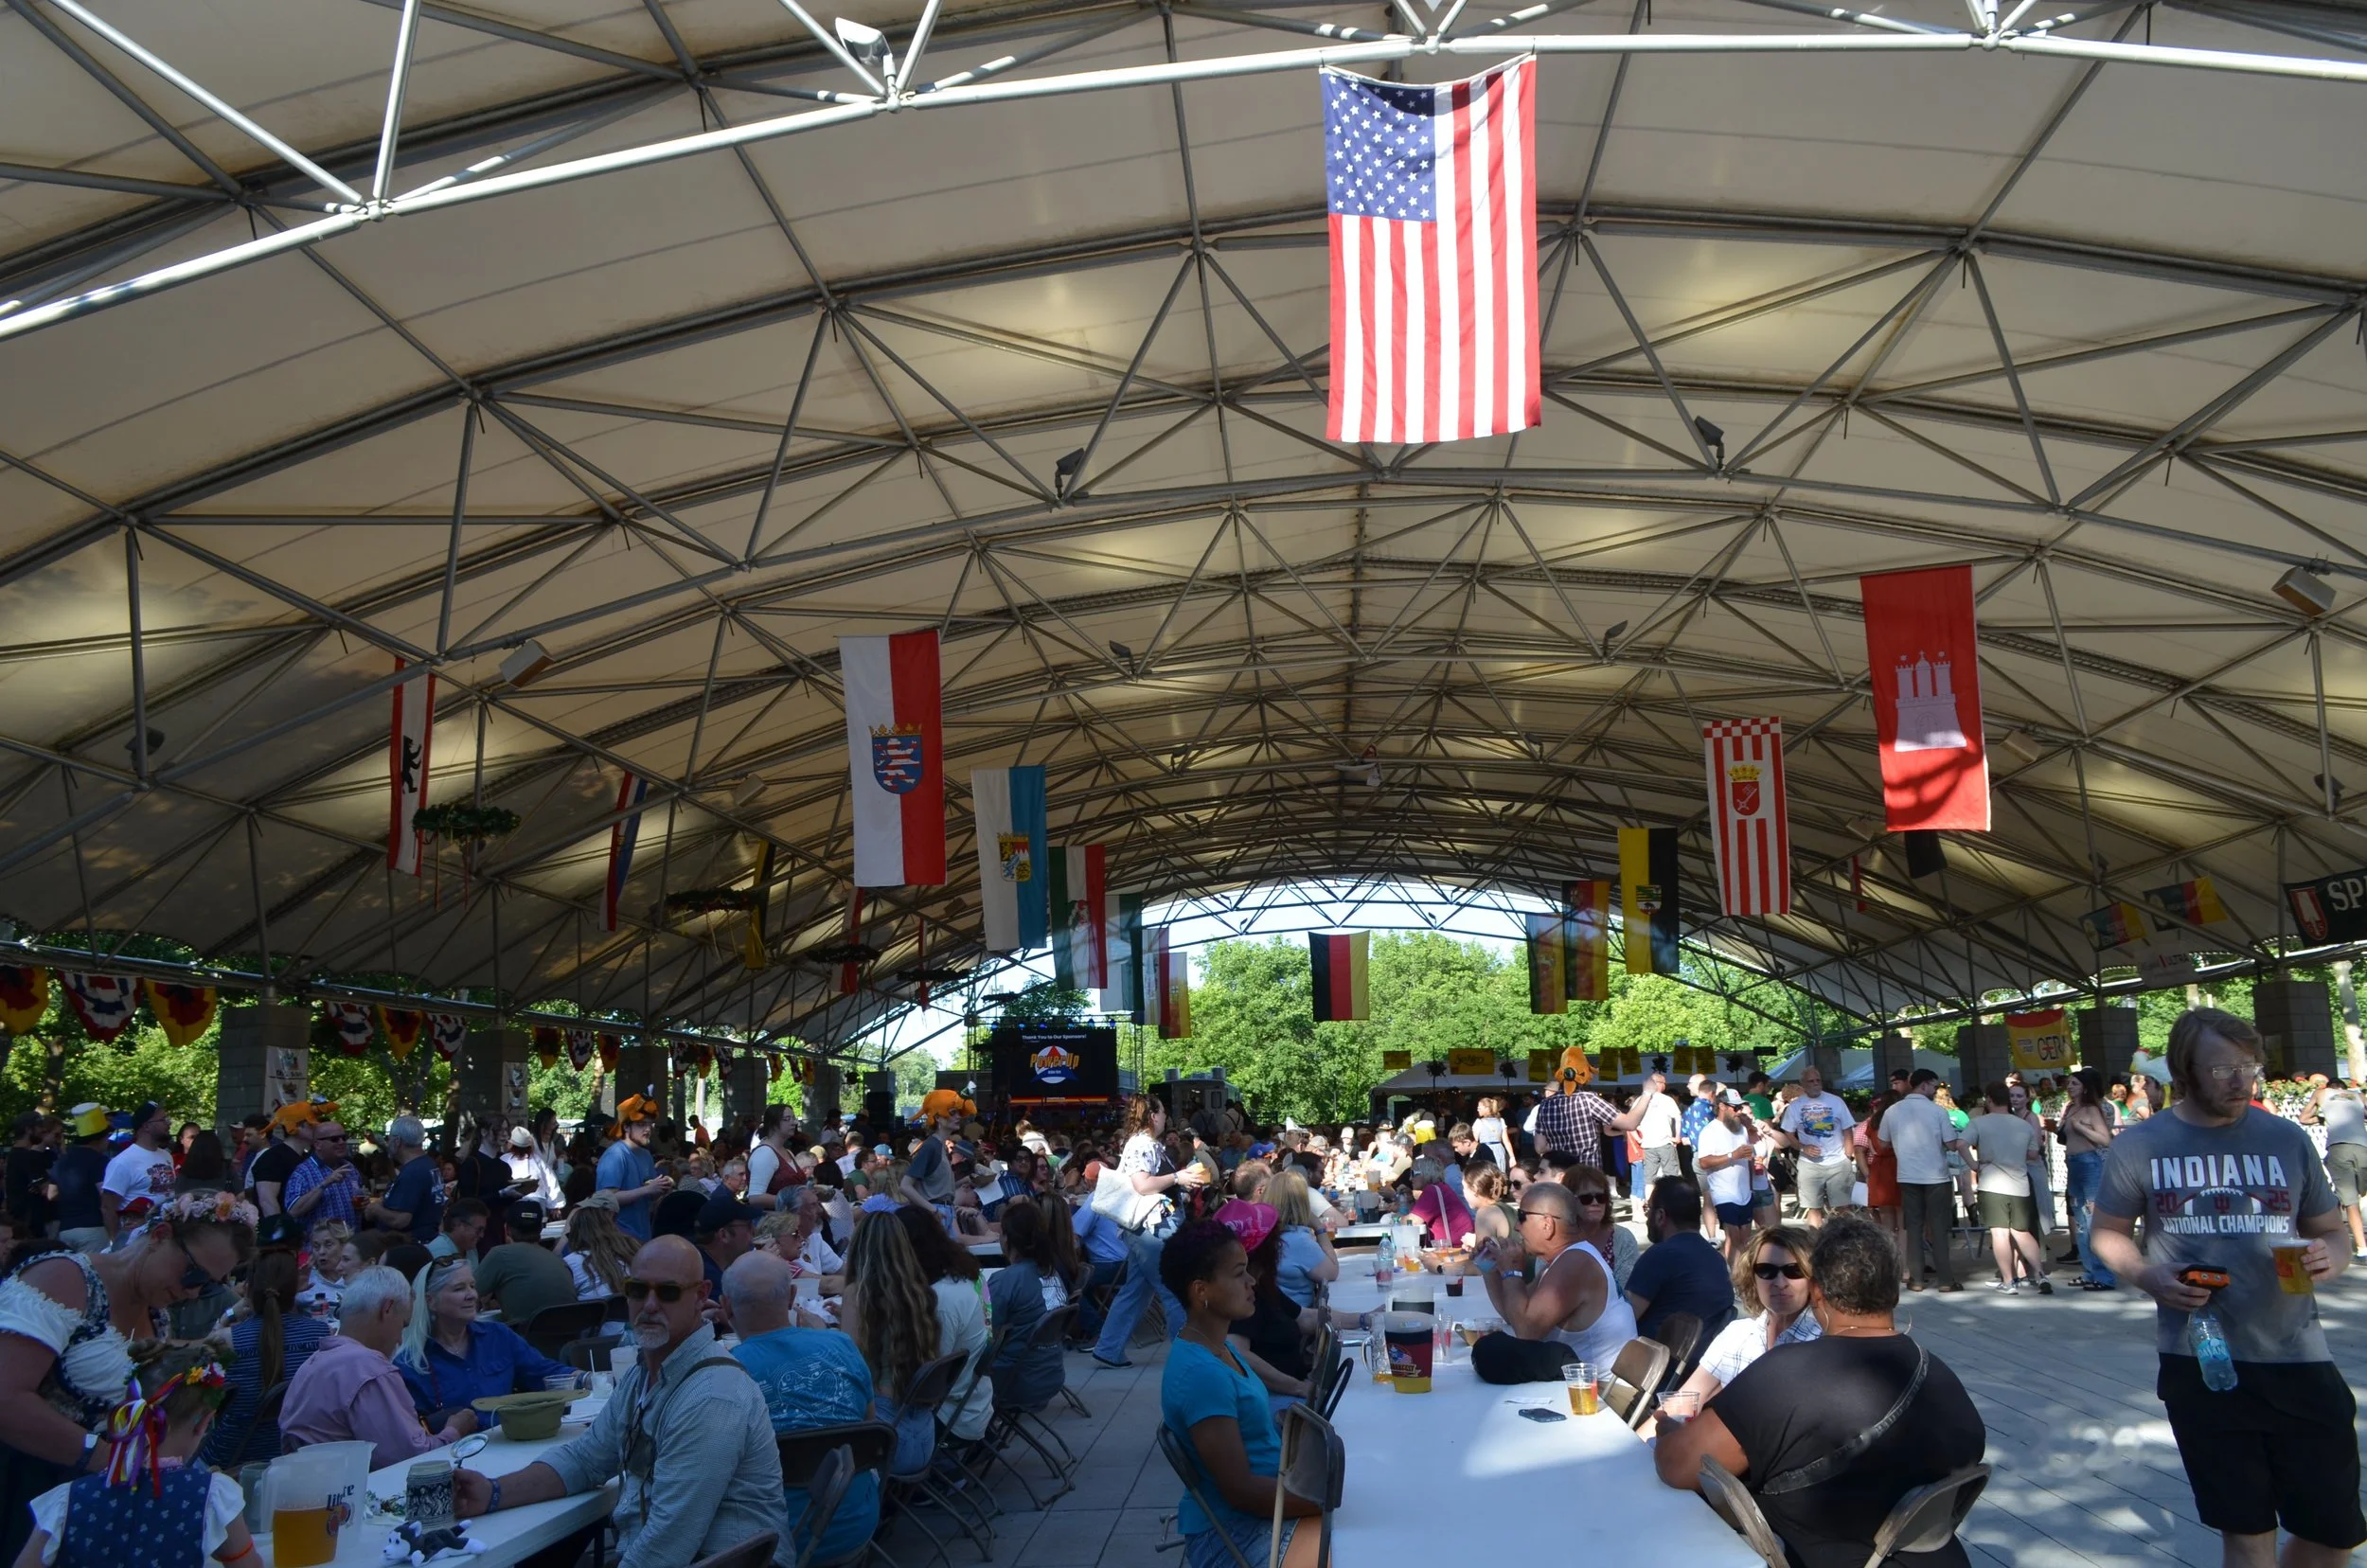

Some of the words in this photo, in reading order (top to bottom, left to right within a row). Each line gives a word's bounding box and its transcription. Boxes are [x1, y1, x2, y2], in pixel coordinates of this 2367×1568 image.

[2327, 875, 2367, 912] SP
[2150, 1154, 2287, 1190] INDIANA
[2154, 1192, 2178, 1214] 20
[2266, 1189, 2292, 1213] 25
[2160, 1216, 2216, 1235] NATIONAL
[2218, 1215, 2290, 1235] CHAMPIONS
